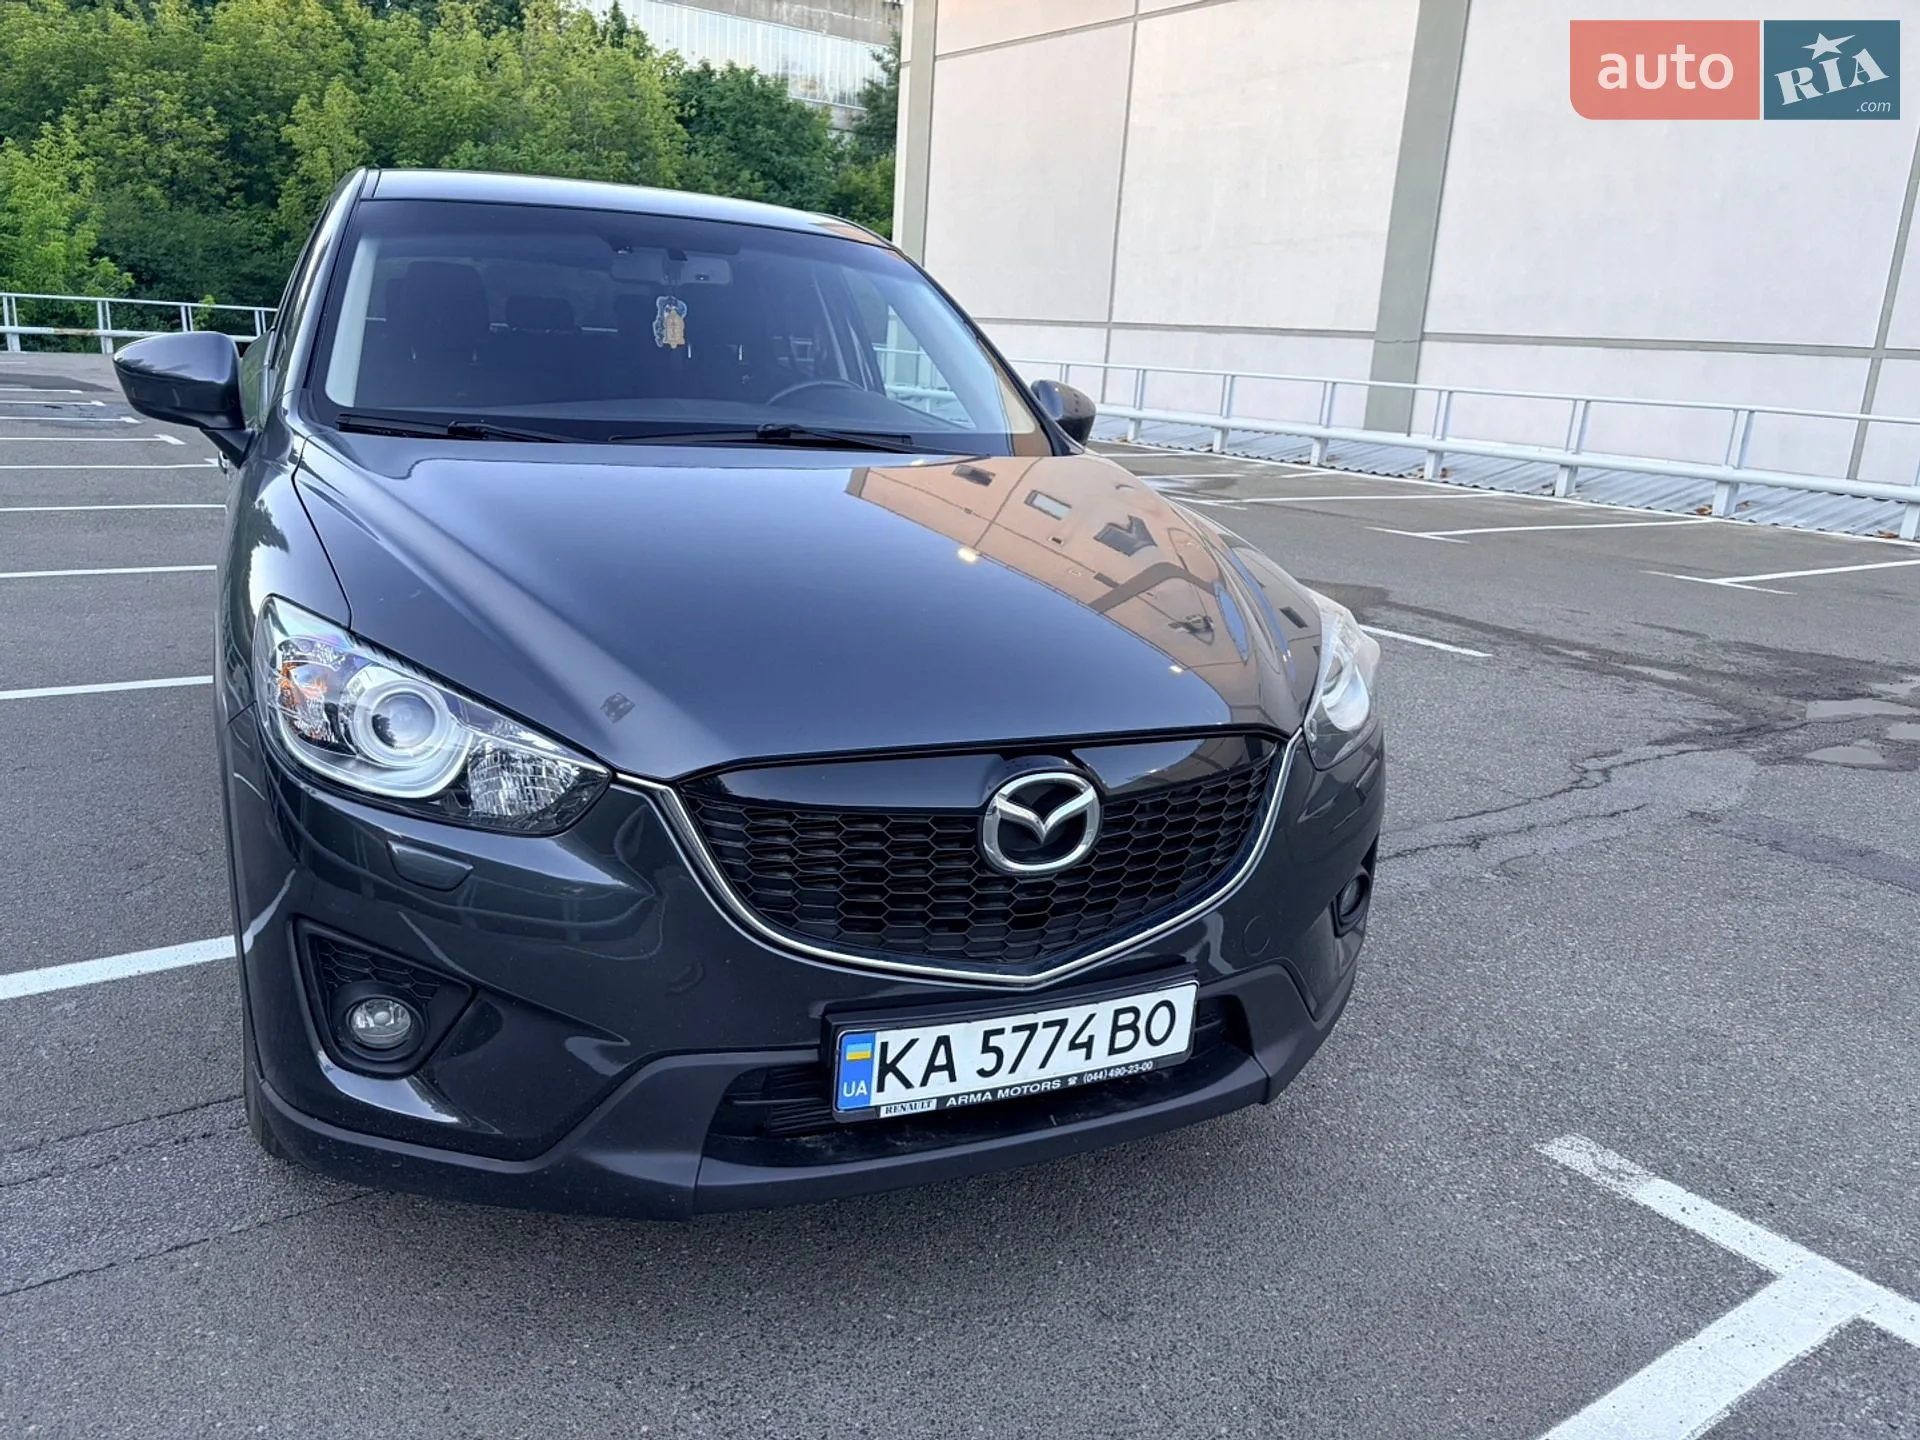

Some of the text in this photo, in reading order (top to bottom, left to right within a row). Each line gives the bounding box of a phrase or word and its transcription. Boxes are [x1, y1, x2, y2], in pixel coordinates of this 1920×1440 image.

[876, 999, 1176, 1093] KA 5774 BO
[843, 1083, 868, 1097] UA
[885, 1100, 932, 1115] RENAULT
[946, 1091, 992, 1107] ARMA
[997, 1079, 1062, 1100] MOTORS
